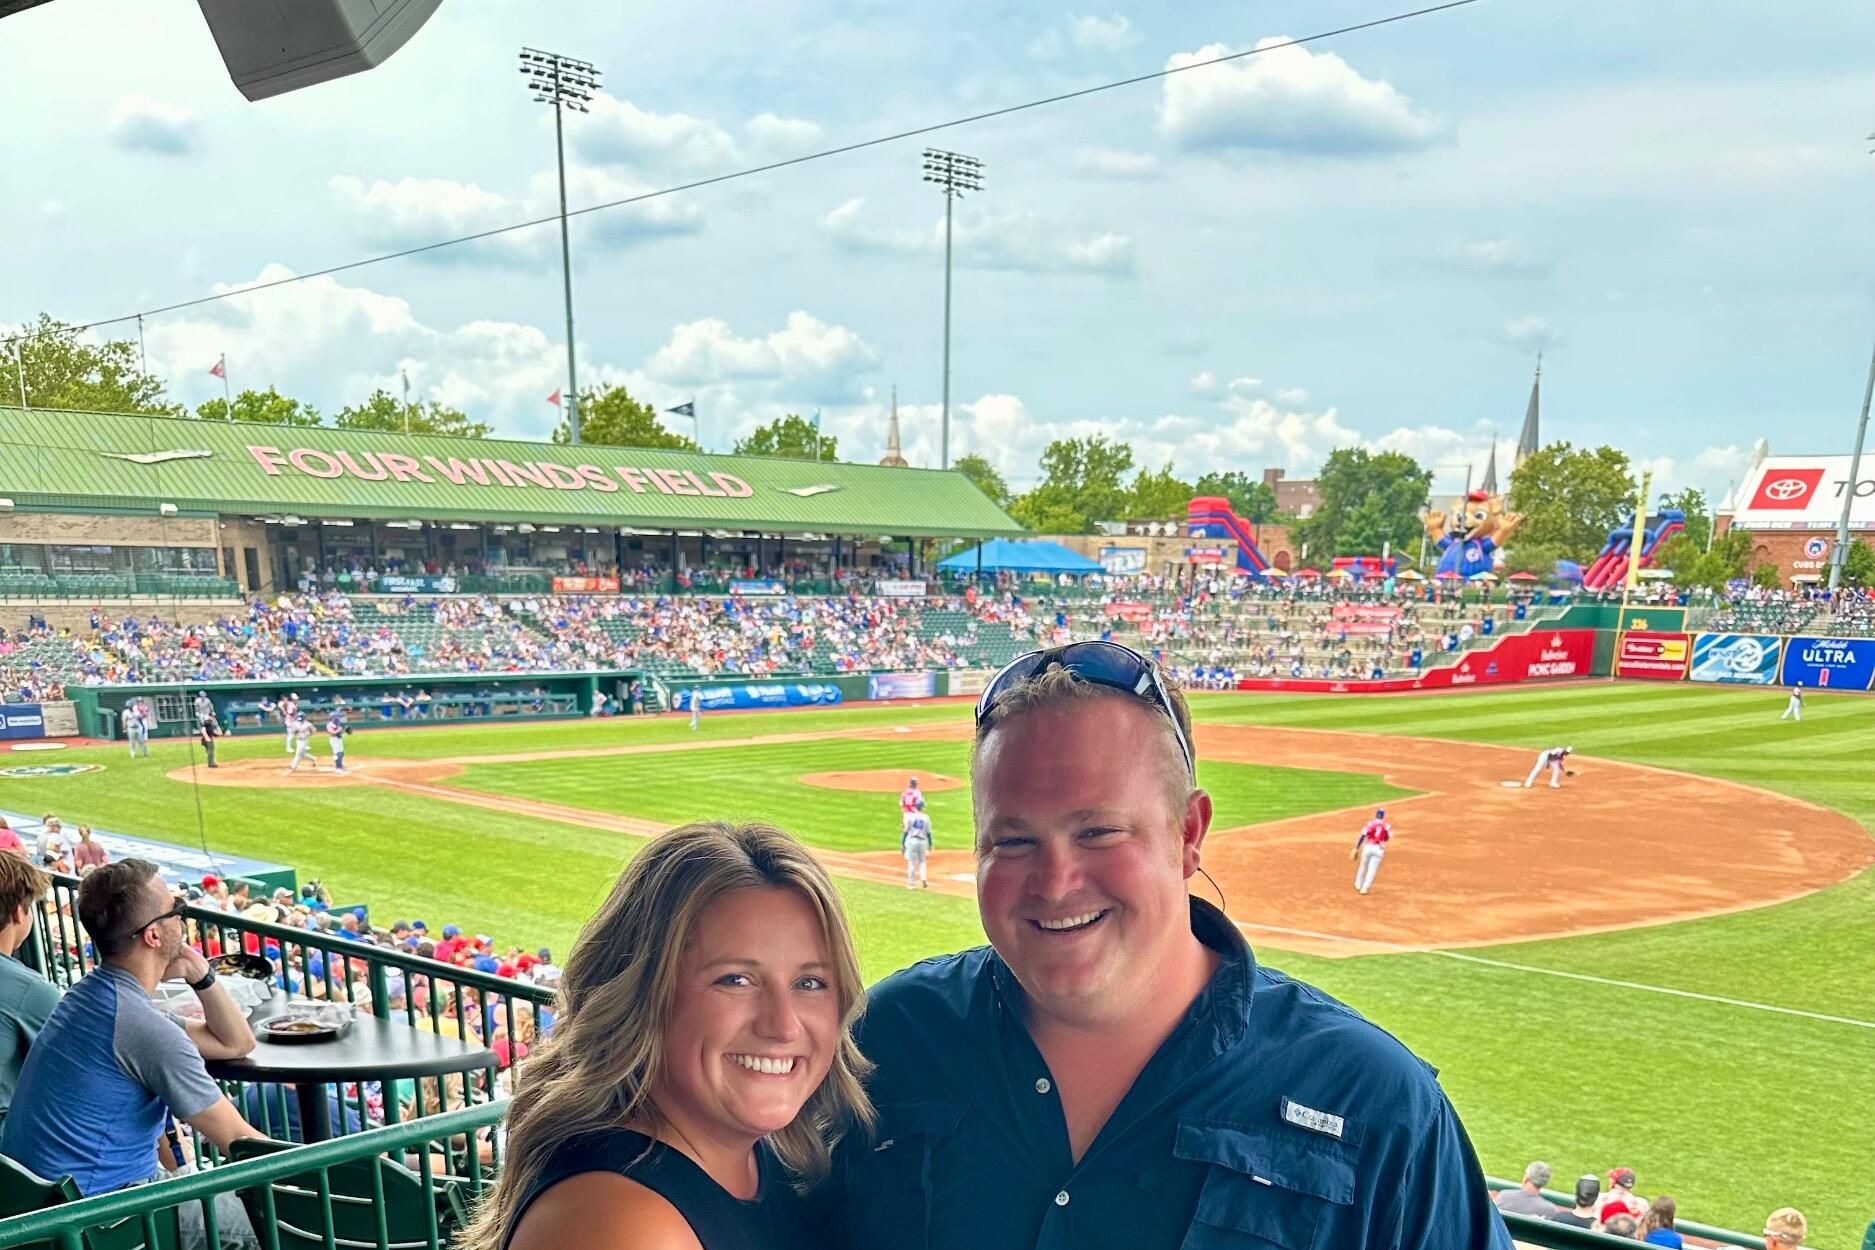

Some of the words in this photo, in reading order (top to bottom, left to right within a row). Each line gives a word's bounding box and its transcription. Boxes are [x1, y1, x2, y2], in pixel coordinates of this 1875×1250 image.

[246, 445, 436, 483] FOUR
[423, 455, 620, 493] WINDS
[614, 466, 753, 498] FIELD
[1802, 648, 1856, 663] ULTRA
